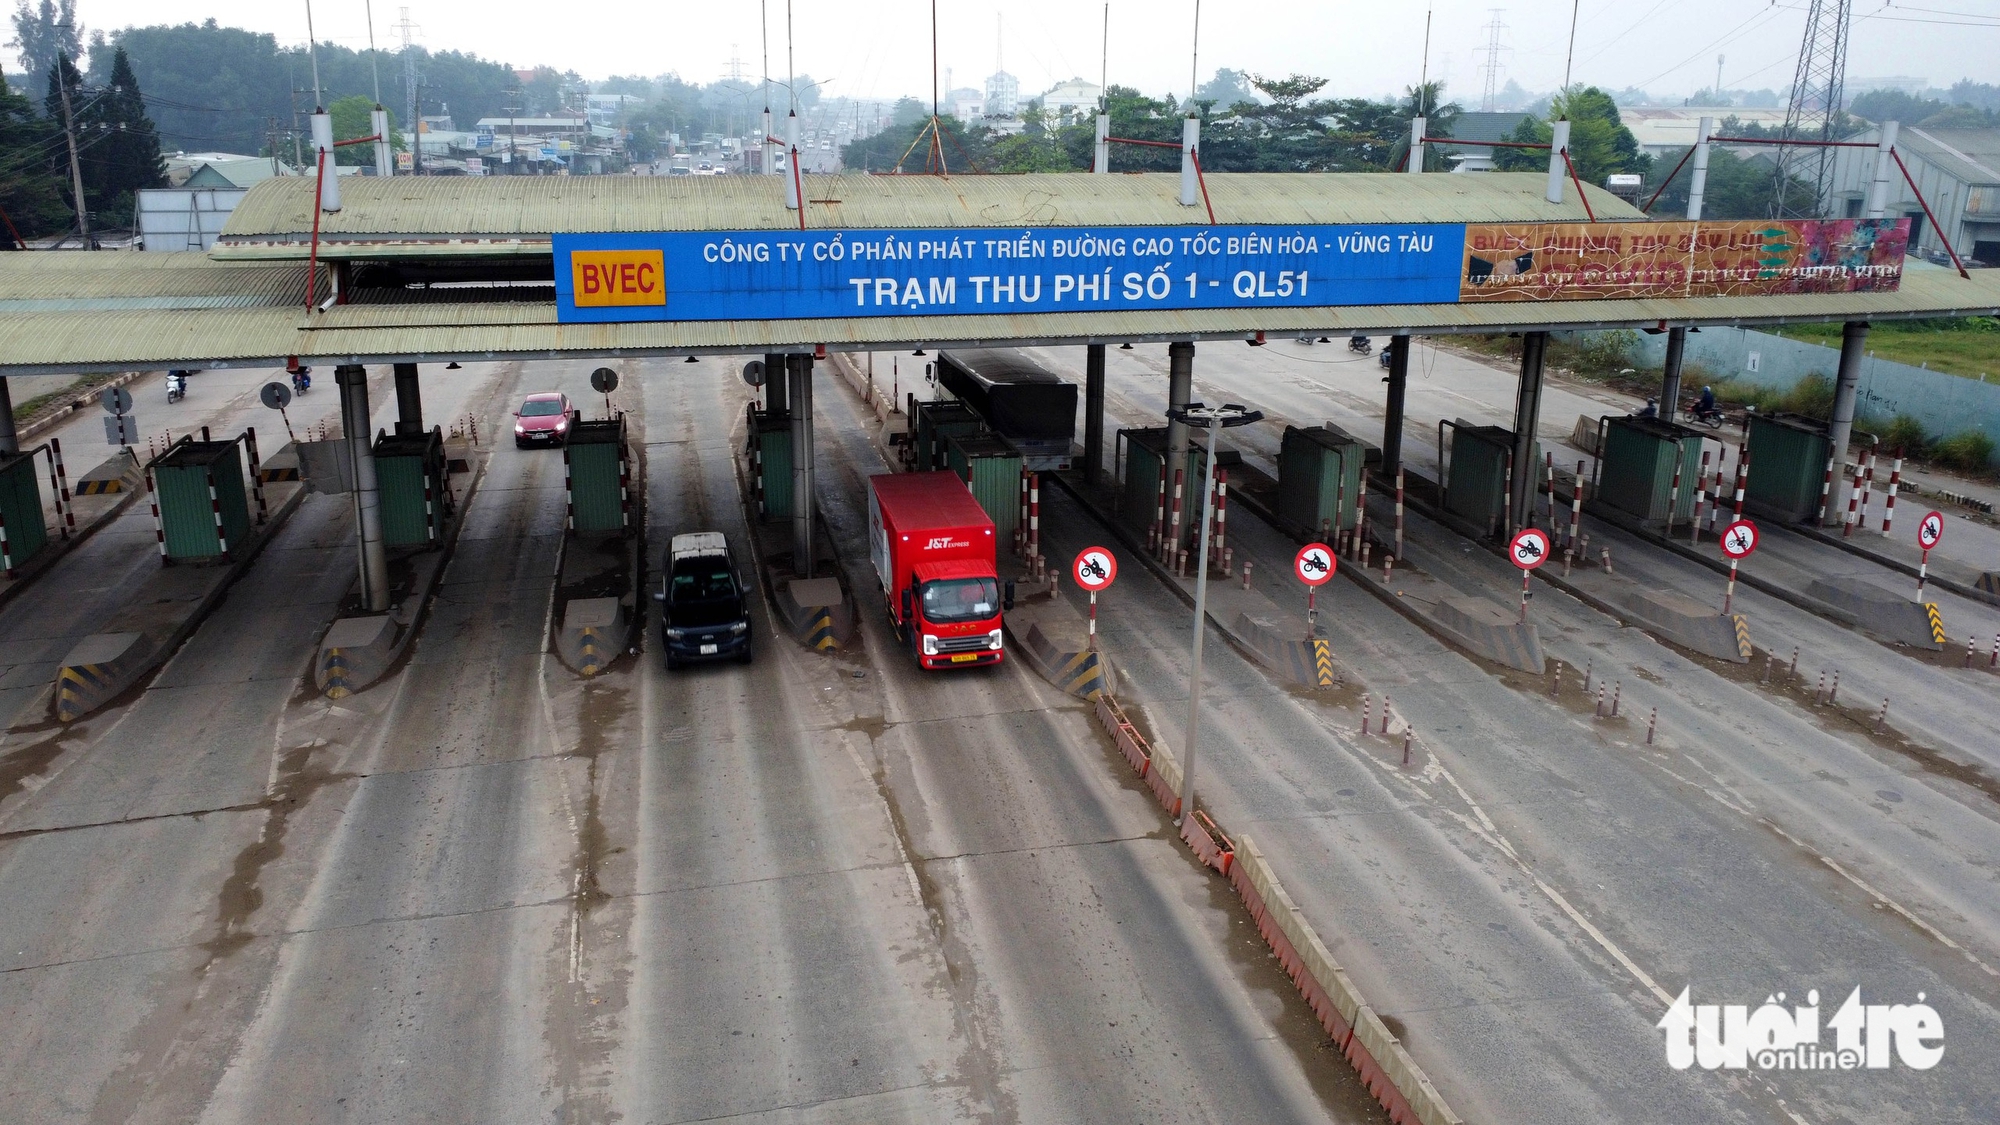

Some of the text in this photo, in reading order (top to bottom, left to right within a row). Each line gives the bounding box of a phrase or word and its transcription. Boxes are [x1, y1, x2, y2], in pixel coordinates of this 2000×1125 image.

[703, 238, 769, 263] CÔNG
[776, 242, 806, 262] TY
[813, 231, 845, 261] CỔ
[852, 234, 912, 260] PHẦN
[919, 236, 976, 260] PHÁT
[983, 230, 1045, 258] TRIỂN
[1052, 233, 1126, 258] ĐƯỜNG
[1132, 237, 1174, 256] CAO
[1180, 231, 1221, 256] TỐC
[1227, 231, 1273, 255] BIÊN
[1278, 231, 1318, 254] HÒA
[1338, 230, 1391, 253] VŨNG
[1397, 230, 1434, 253] TÀU
[1631, 234, 1671, 253] TAY
[582, 263, 655, 294] BVEC
[849, 277, 957, 309] TRẠM
[968, 275, 1041, 304] THU
[1054, 266, 1111, 302] PHÍ
[1122, 262, 1171, 300] SỐ
[1185, 272, 1197, 299] 1
[1233, 270, 1308, 298] QL51
[924, 537, 953, 550] J&T
